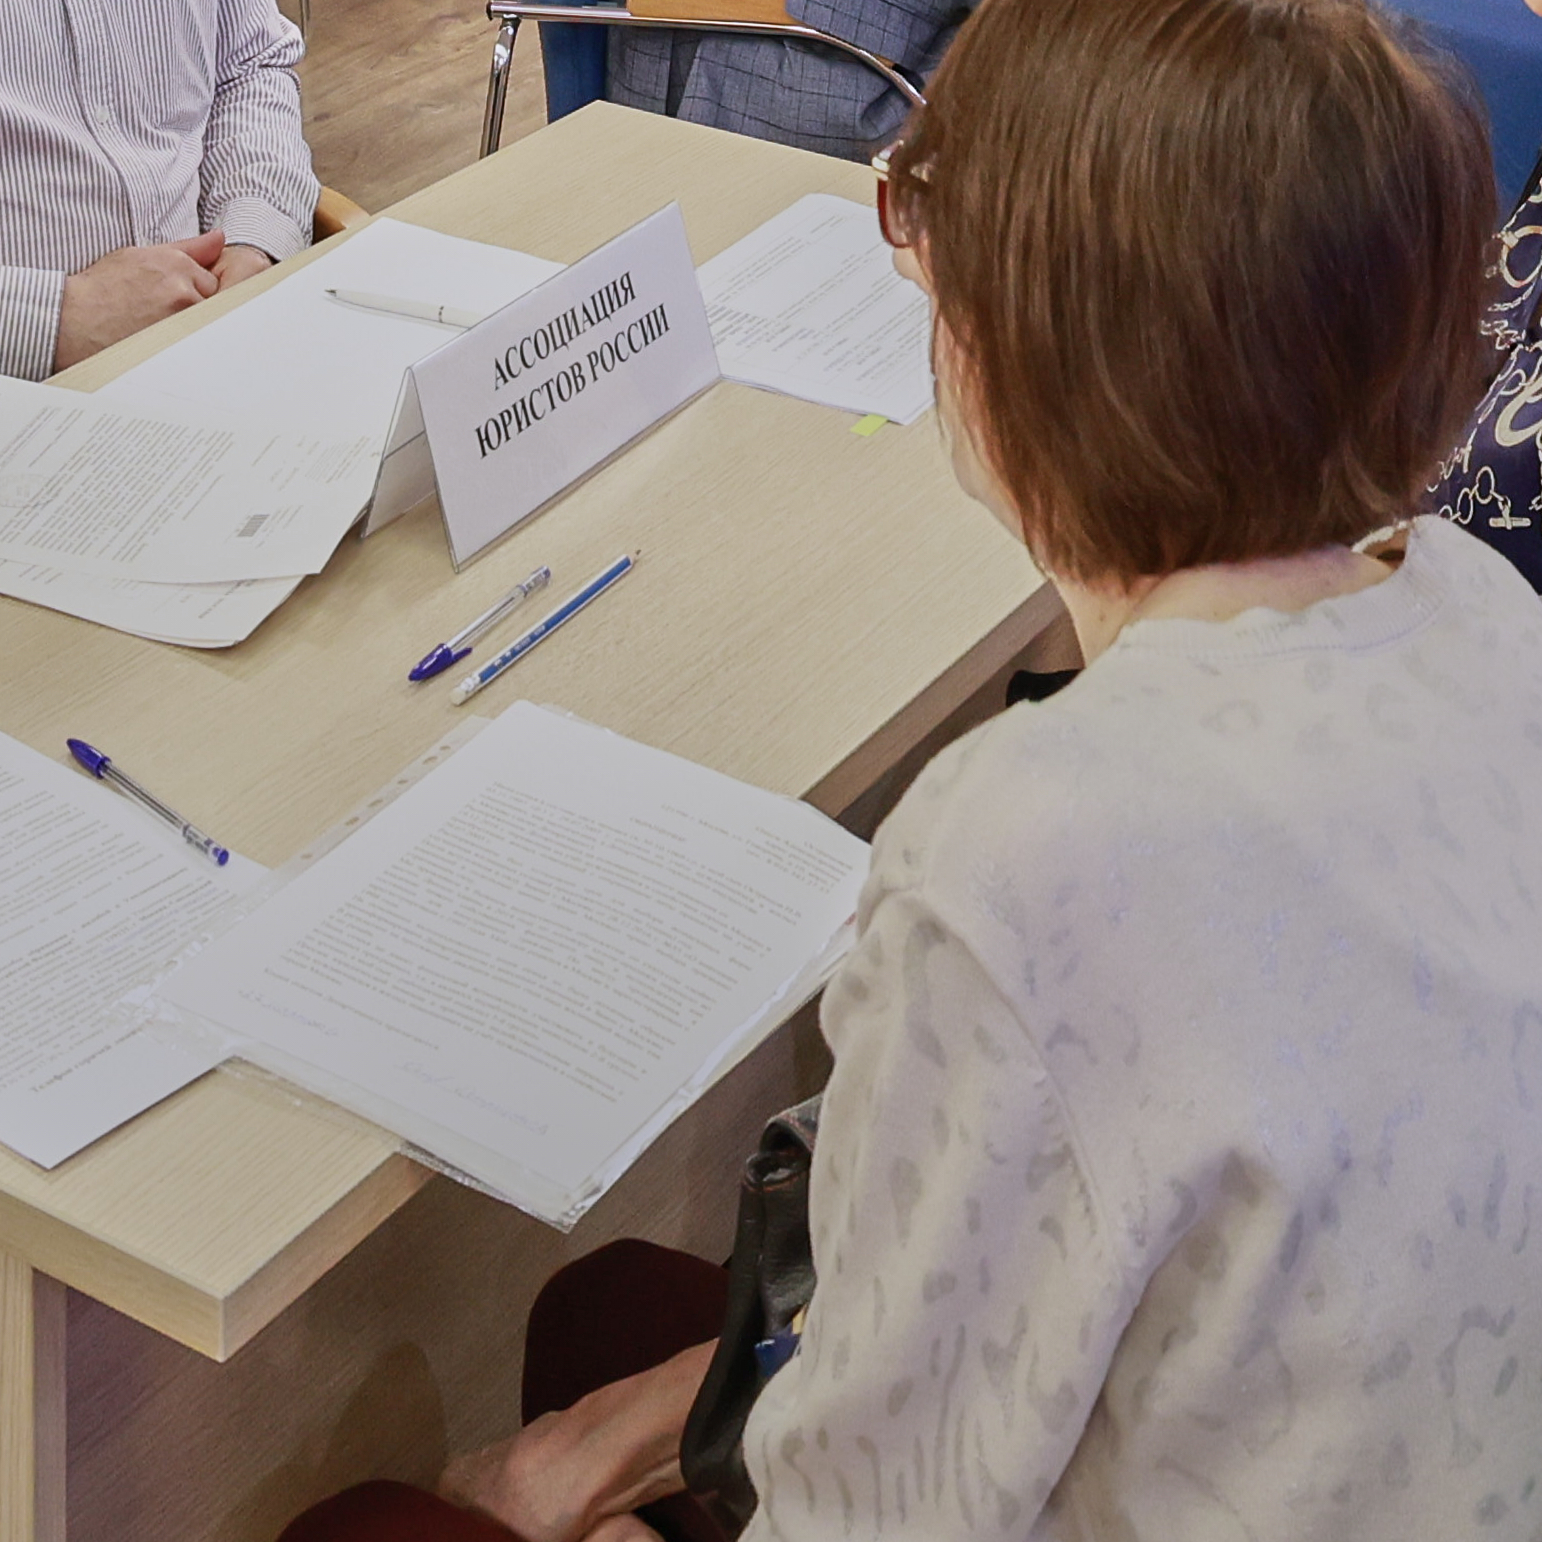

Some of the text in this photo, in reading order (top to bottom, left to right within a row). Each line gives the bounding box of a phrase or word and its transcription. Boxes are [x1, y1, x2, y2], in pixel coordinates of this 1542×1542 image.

[474, 303, 672, 460] ЮРИСТОВ РОССИИ
[493, 271, 637, 392] АССОЦИАЦИЯ
